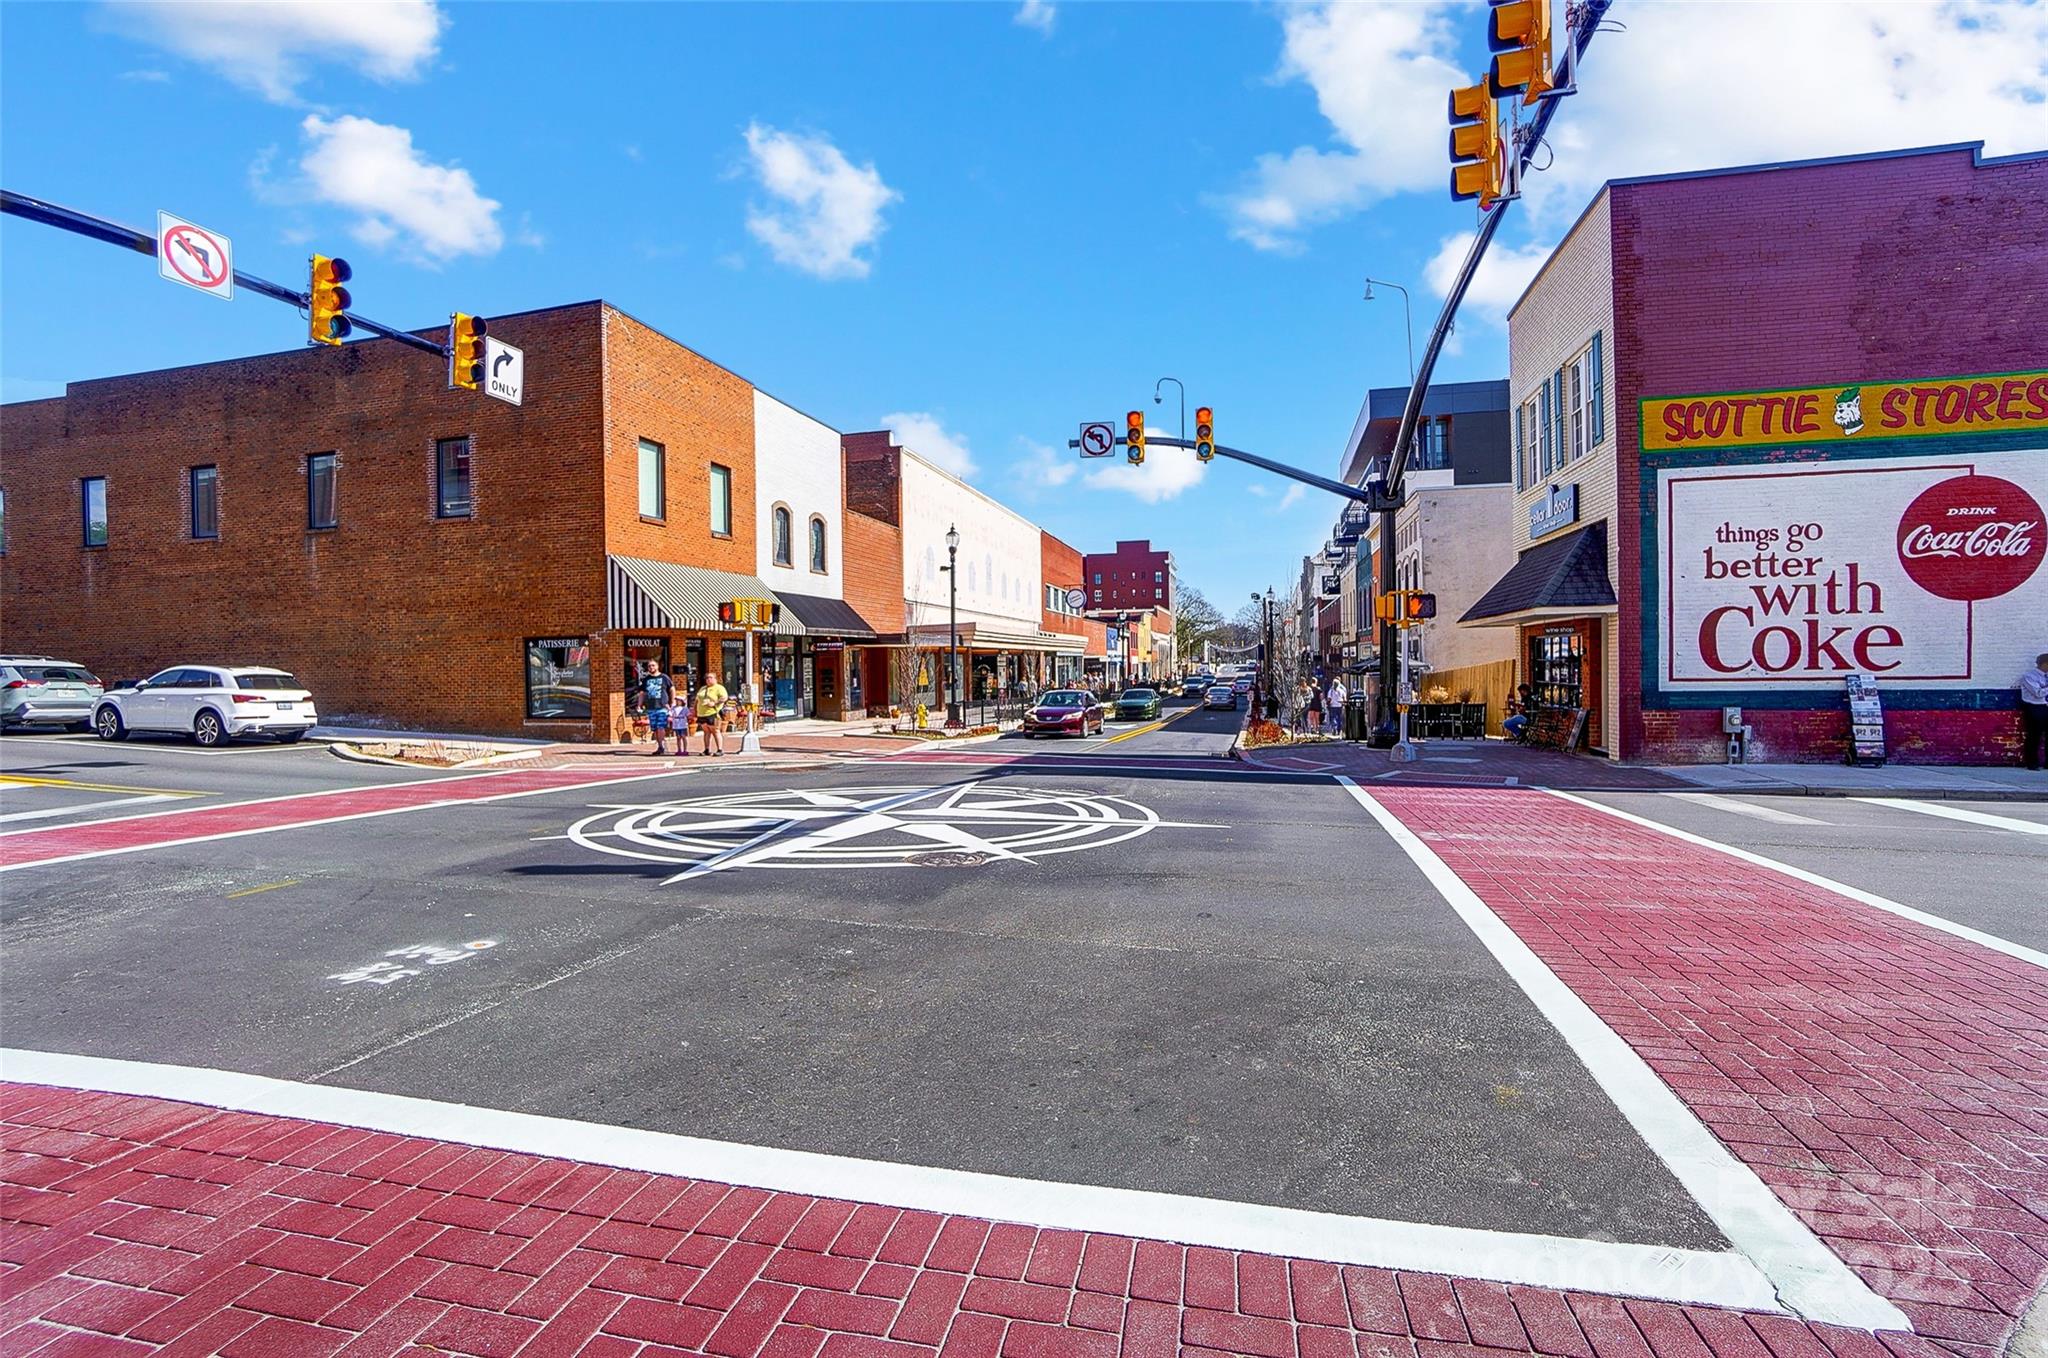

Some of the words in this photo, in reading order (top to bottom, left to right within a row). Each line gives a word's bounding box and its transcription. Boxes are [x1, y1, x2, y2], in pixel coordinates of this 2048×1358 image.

[492, 380, 518, 398] ONLY
[1664, 395, 1820, 441] SCOTTIE
[1881, 378, 2048, 428] STORES
[1946, 506, 1998, 516] DRINK
[1716, 522, 1779, 550] things
[1786, 523, 1823, 552] go
[1902, 520, 2039, 558] Coca-Cola
[1703, 546, 1823, 579] better
[1749, 563, 1884, 616] with
[538, 639, 580, 649] PATISSERIE
[627, 638, 661, 647] CHOCOLAT
[1698, 606, 1904, 673] Coke
